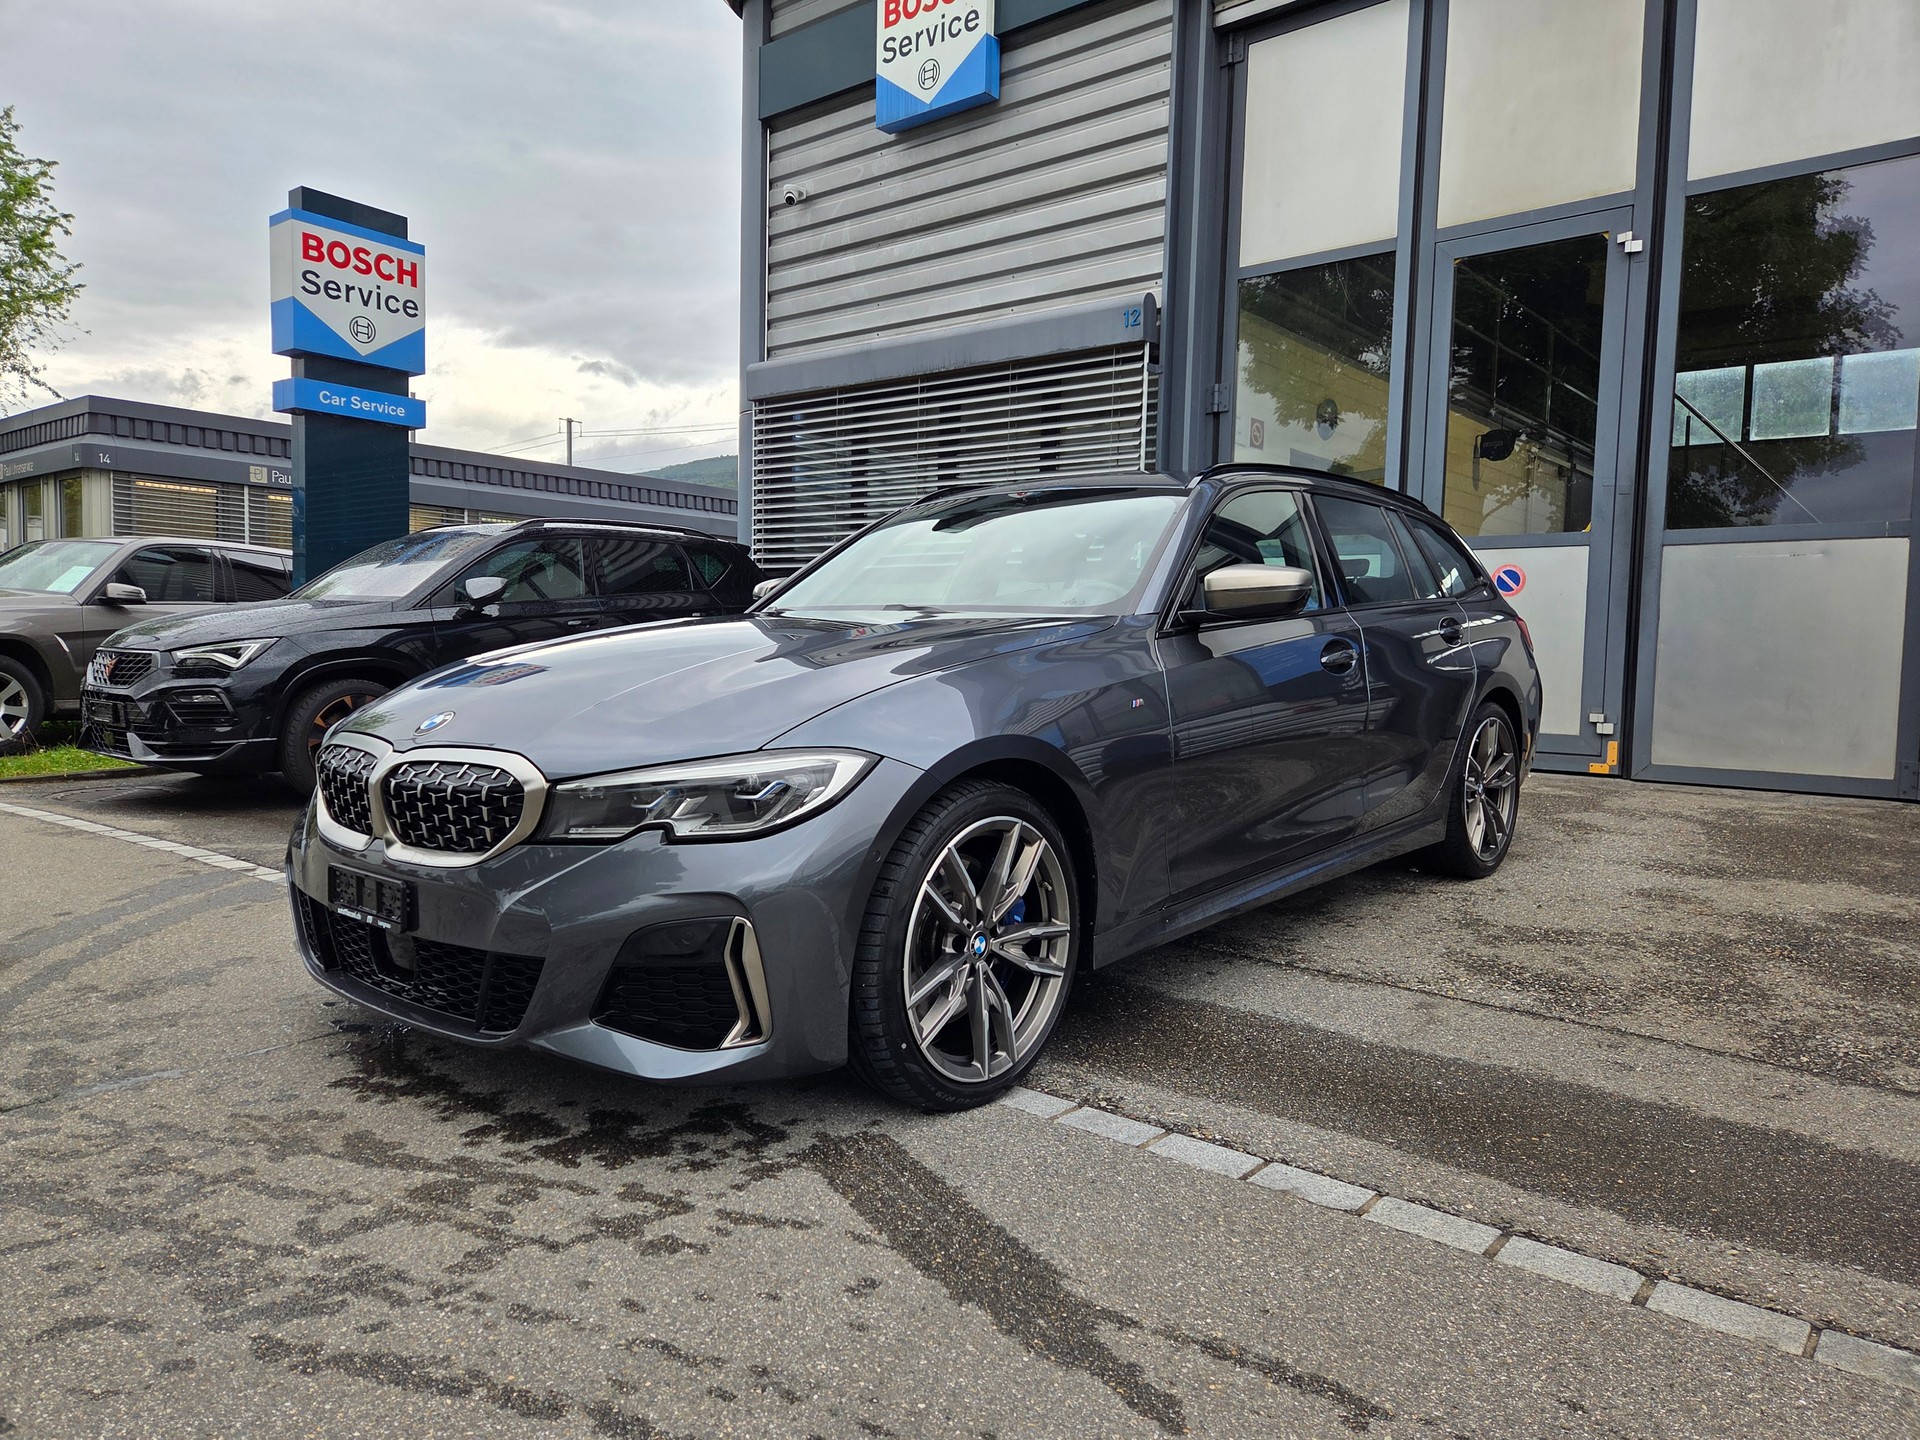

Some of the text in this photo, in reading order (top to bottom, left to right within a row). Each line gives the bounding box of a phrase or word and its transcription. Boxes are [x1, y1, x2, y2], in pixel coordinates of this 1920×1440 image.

[885, 0, 955, 29] BO
[882, 9, 980, 64] Service
[302, 231, 418, 288] BOSCH
[301, 269, 419, 318] Service
[1123, 307, 1141, 328] 12
[319, 390, 406, 417] Car Service
[99, 453, 111, 464] 14
